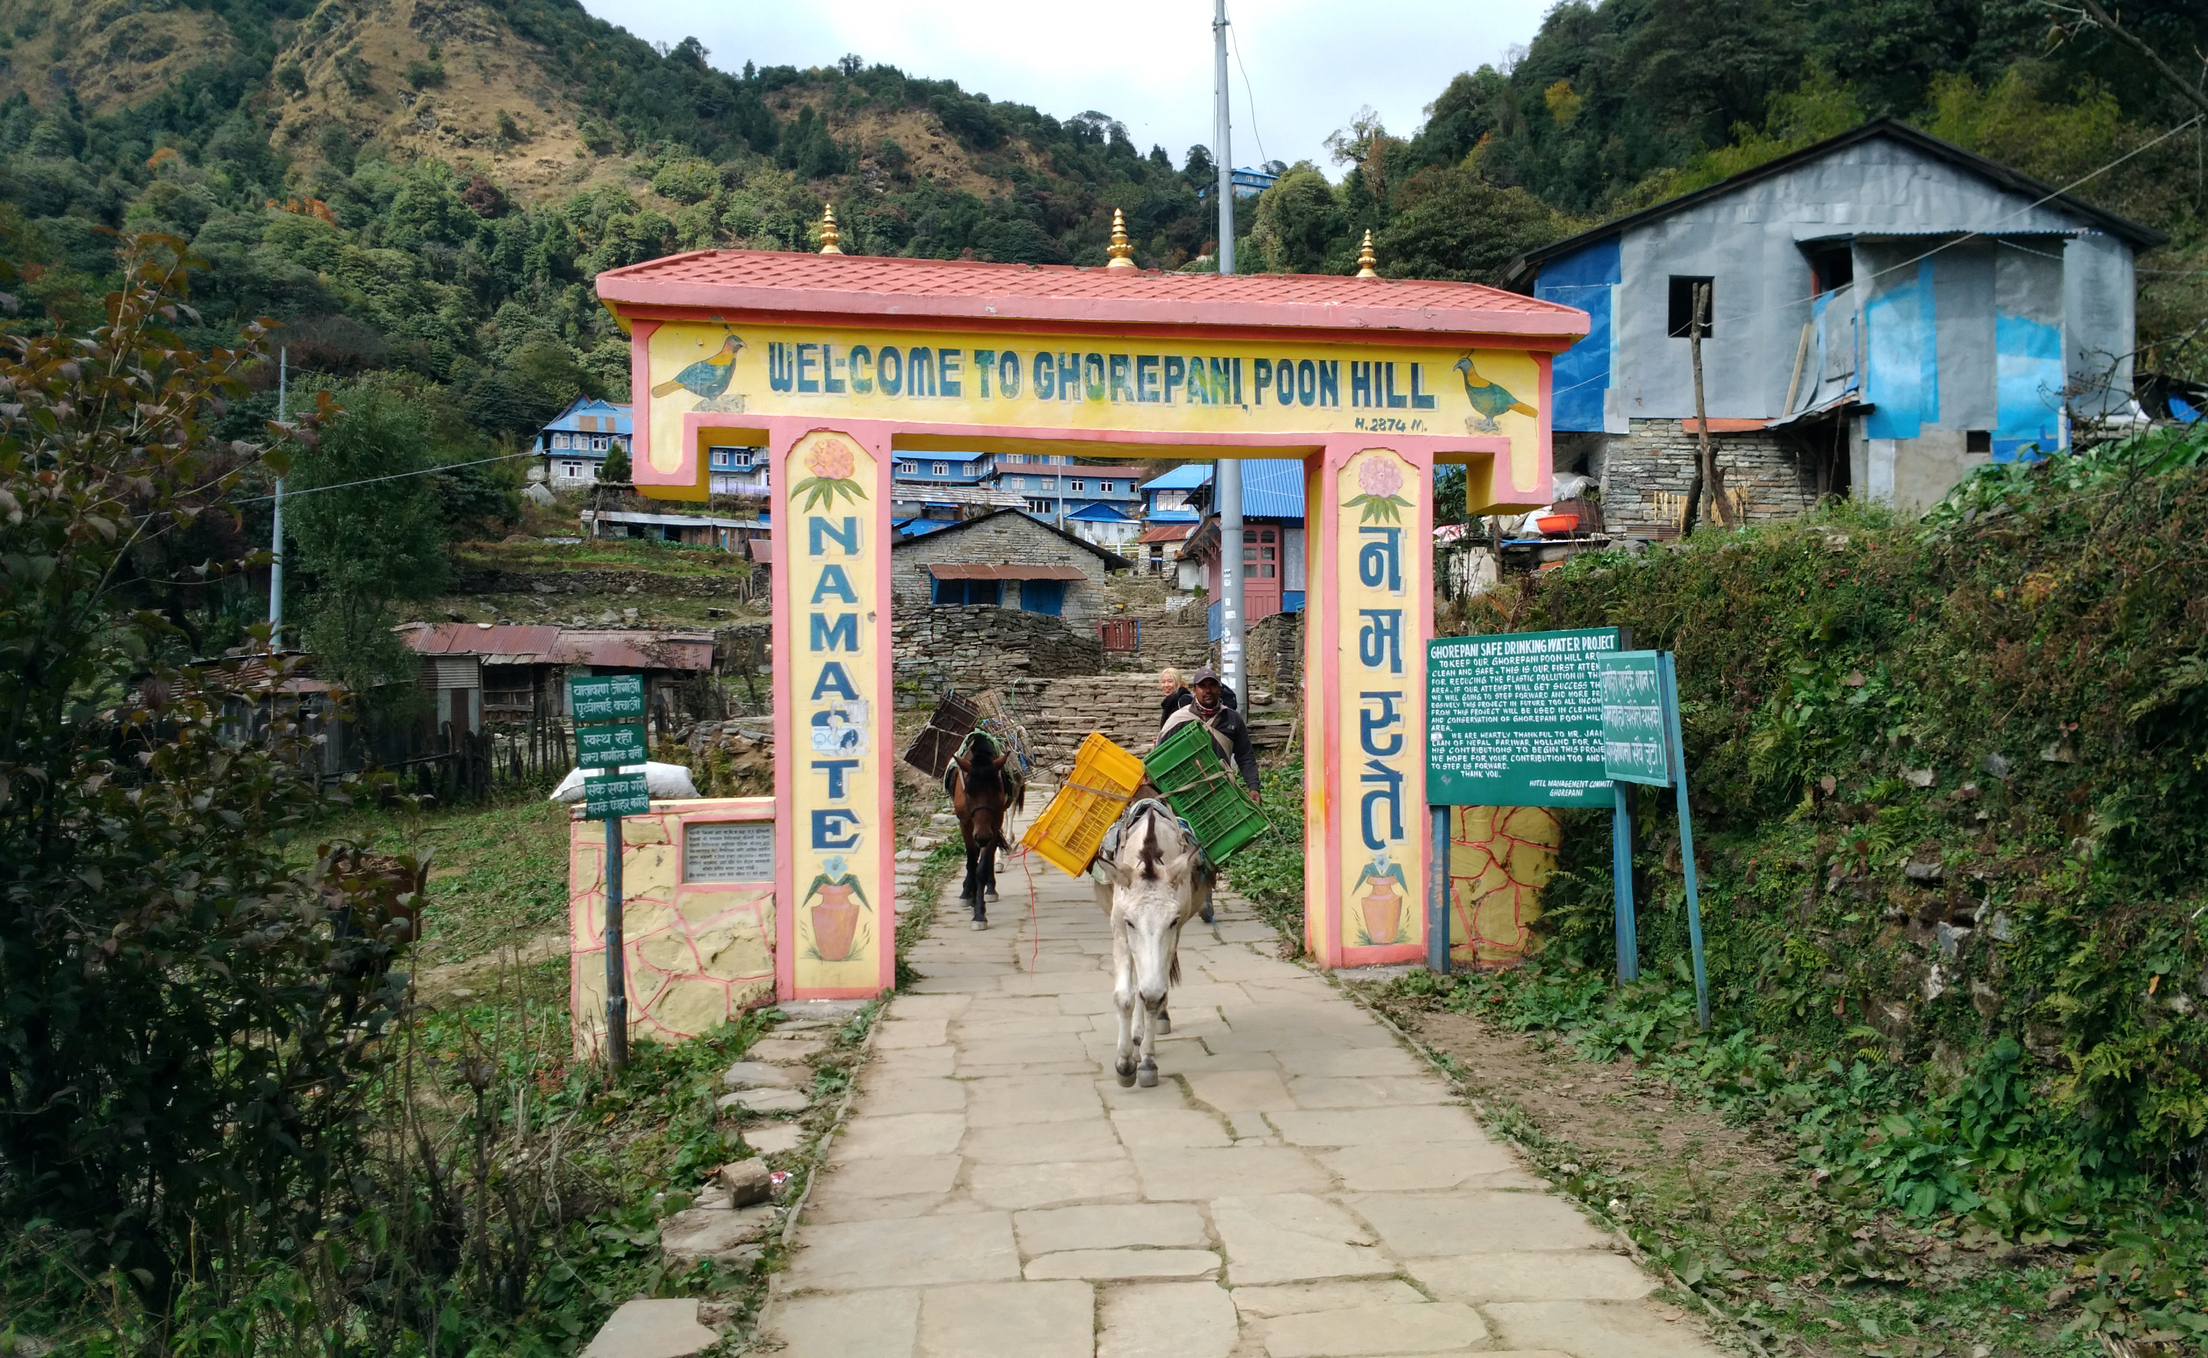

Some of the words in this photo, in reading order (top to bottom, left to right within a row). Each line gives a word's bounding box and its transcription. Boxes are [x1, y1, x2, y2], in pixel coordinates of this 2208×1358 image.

[974, 349, 1021, 399] TO
[1254, 358, 1340, 408] POON
[1351, 361, 1436, 409] HILL
[1431, 644, 1478, 659] GHOREPANI
[1481, 642, 1502, 656] SAFE
[1505, 639, 1547, 655] DRINKING
[1548, 637, 1580, 652] WATER
[1582, 635, 1615, 650] PROJECT
[1439, 660, 1448, 668] TO
[1450, 659, 1470, 667] KEEP
[1473, 658, 1489, 666] OUR
[1492, 655, 1539, 665] GHOREPANI
[1541, 654, 1562, 662] POON
[1564, 653, 1581, 661] HILL
[1585, 652, 1599, 660] AR
[1459, 668, 1472, 676] AND
[1501, 666, 1519, 674] THIS
[1533, 665, 1550, 673] OUR
[1552, 664, 1574, 672] FIRST
[1450, 677, 1486, 685] REDUCING
[1490, 675, 1503, 683] THE
[1507, 674, 1534, 683] PLASTIC
[1537, 672, 1575, 681] POLLUTION
[1515, 684, 1530, 692] WILL
[1534, 683, 1550, 691] GET
[1553, 682, 1587, 690] SUCCESS
[1568, 690, 1588, 698] MORE
[1470, 708, 1499, 716] PROJECT
[1447, 716, 1498, 724] CONSERVATION
[1460, 770, 1483, 778] THANK
[1548, 780, 1588, 788] MANAGEMENT
[1549, 789, 1583, 797] GHOREPANI
